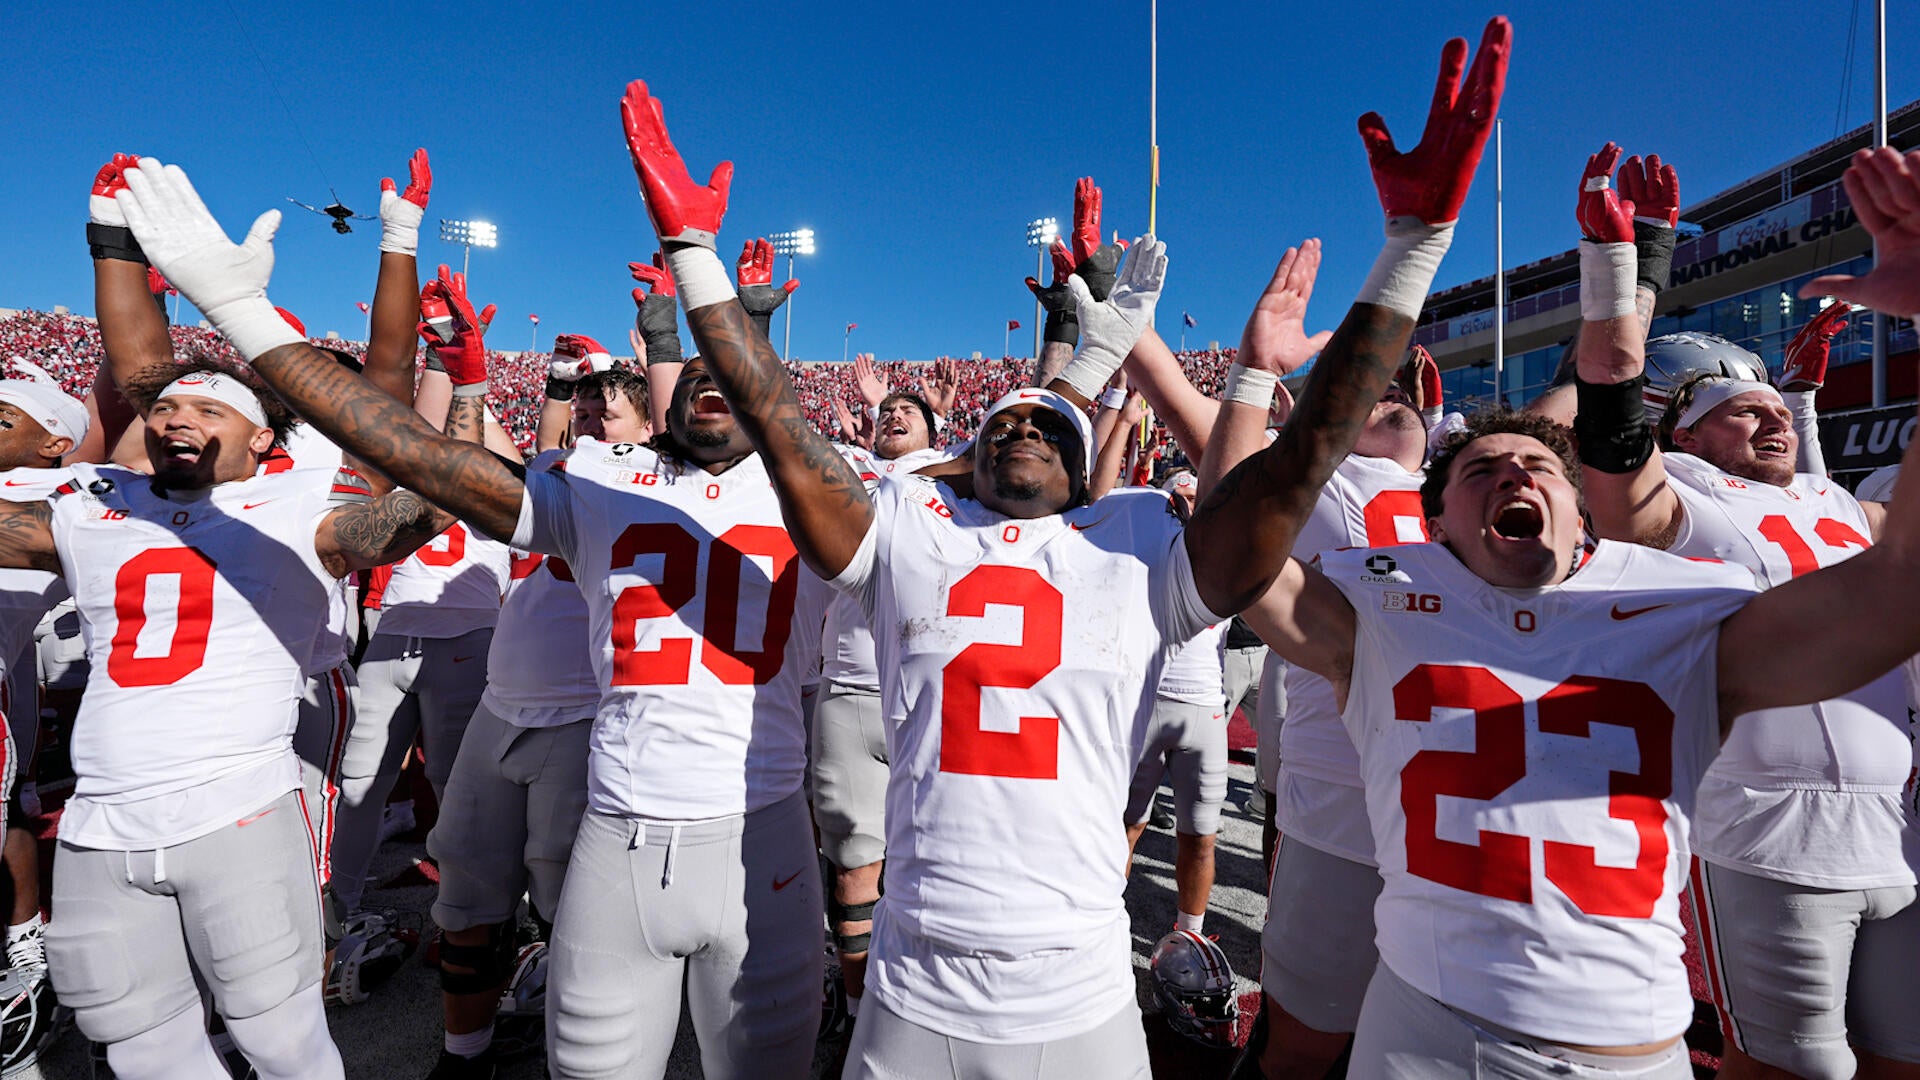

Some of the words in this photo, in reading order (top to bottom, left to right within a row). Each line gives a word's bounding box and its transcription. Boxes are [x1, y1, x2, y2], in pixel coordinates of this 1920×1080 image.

[1670, 230, 1798, 288] NATIONAL
[602, 456, 632, 465] CHASE
[107, 546, 217, 688] 0
[610, 523, 799, 687] 20
[940, 564, 1063, 780] 2
[1393, 664, 1675, 919] 23
